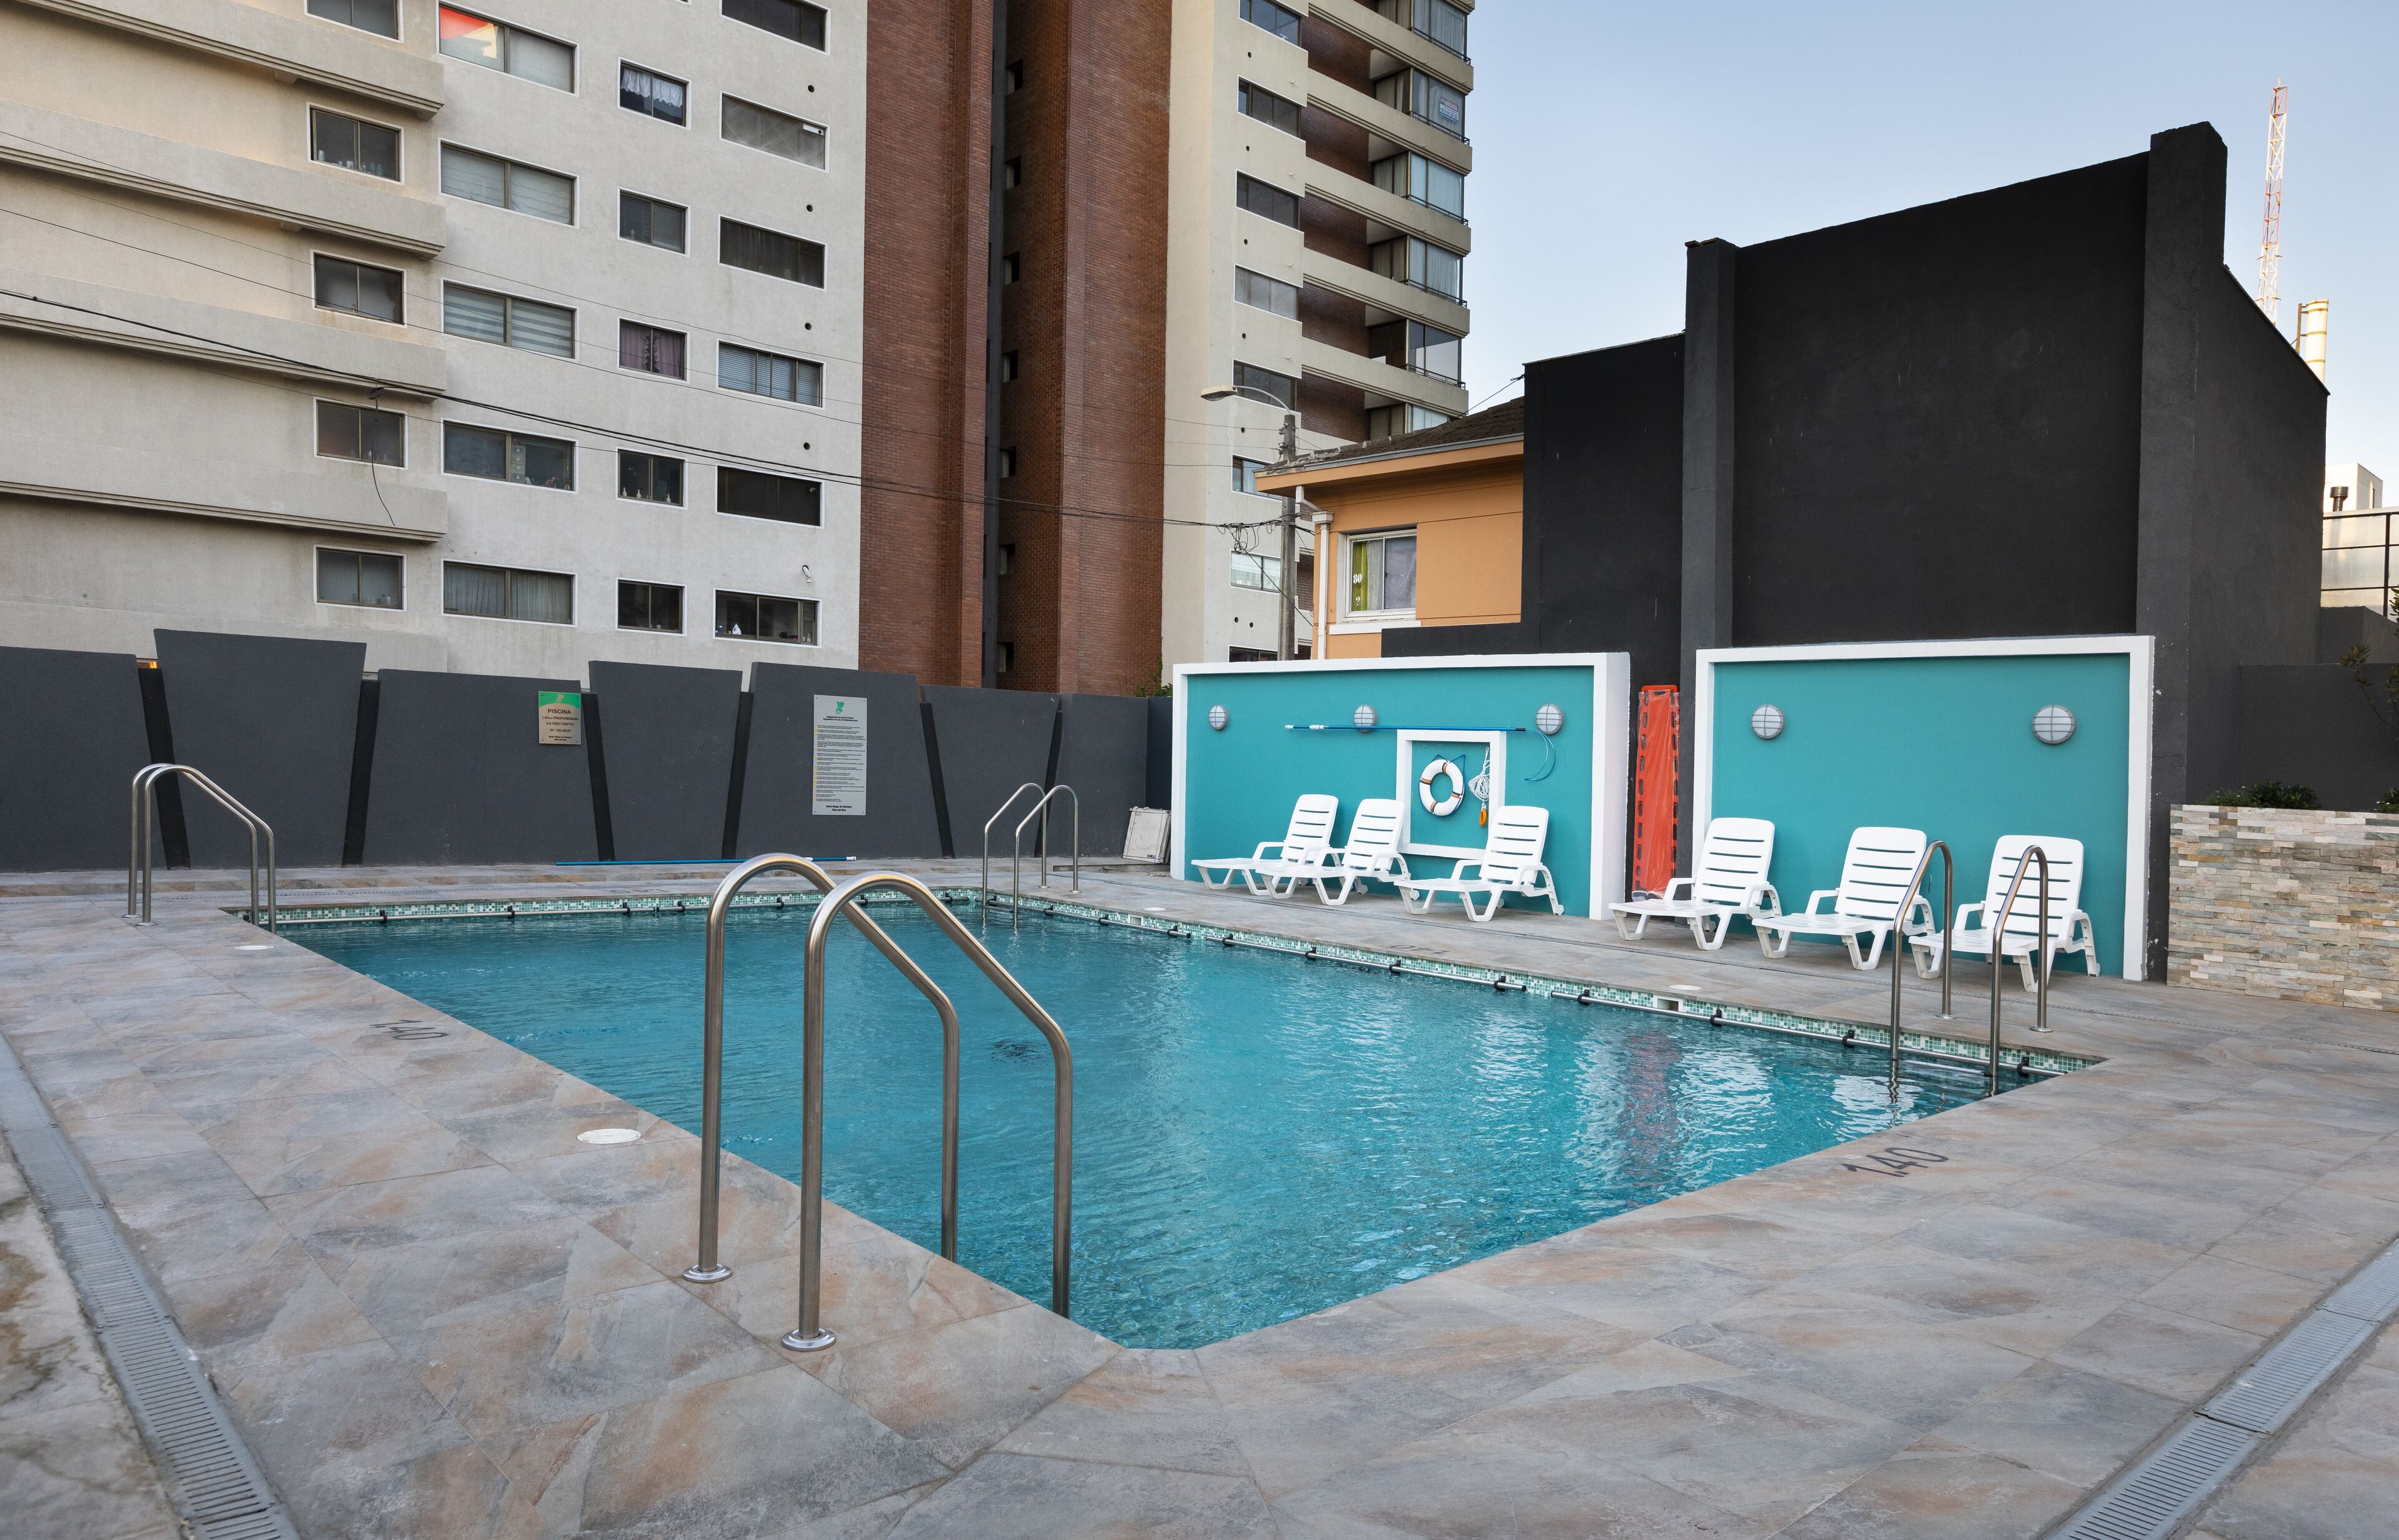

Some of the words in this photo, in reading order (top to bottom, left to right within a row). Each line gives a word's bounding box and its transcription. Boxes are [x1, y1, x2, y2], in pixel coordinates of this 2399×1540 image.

[1353, 573, 1362, 584] 80
[1355, 596, 1361, 606] 2
[369, 1020, 449, 1040] 1.40
[1841, 1148, 1949, 1178] 1.40
